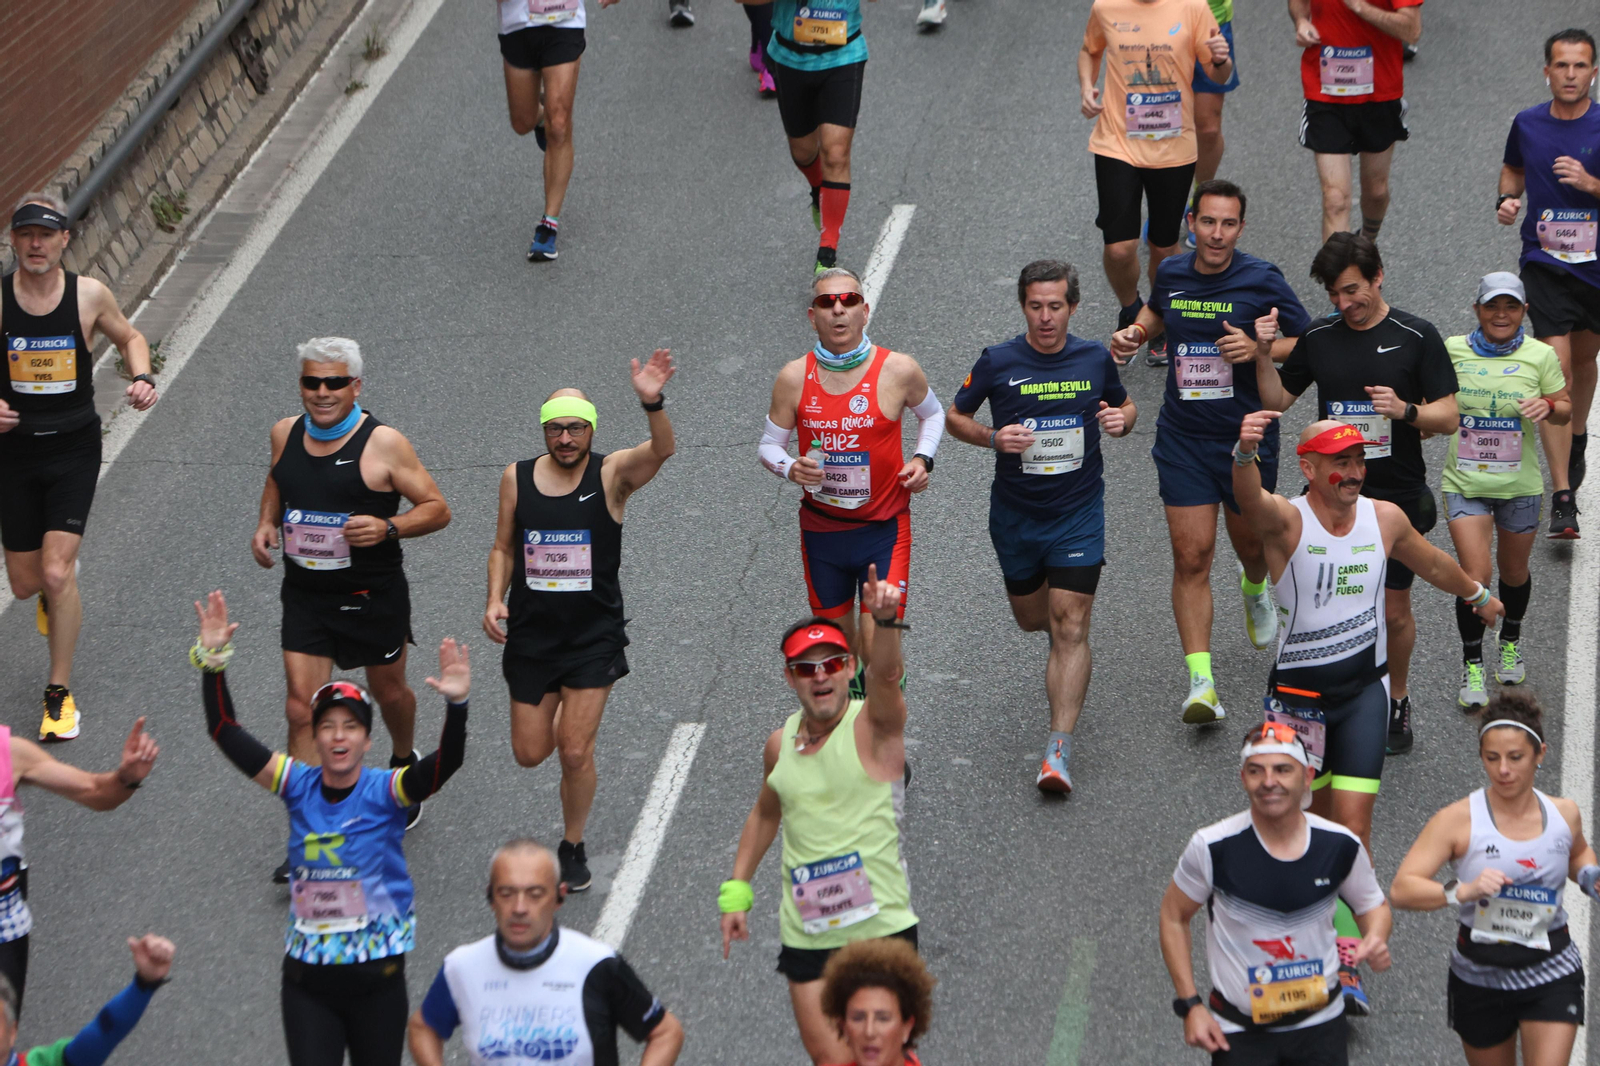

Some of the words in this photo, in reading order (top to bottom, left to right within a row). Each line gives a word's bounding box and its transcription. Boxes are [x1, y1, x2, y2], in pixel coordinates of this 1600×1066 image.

[813, 10, 842, 19] ZURICH
[811, 26, 829, 34] 3751
[1336, 49, 1367, 57] ZURICH
[1145, 94, 1176, 104] ZURICH
[1138, 122, 1171, 130] FERNANDO
[1556, 211, 1590, 220] ZURICH
[1556, 229, 1577, 237] 6464
[1170, 299, 1202, 311] MARATÓN
[1202, 301, 1233, 313] SEVILLA
[30, 339, 68, 349] ZURICH
[30, 359, 53, 368] 6240
[1189, 364, 1211, 373] 7188
[34, 373, 53, 381] YVES
[1020, 381, 1060, 395] MARATÓN
[1060, 380, 1092, 392] SEVILLA
[1183, 379, 1219, 387] RO-MARIO
[1064, 392, 1076, 400] 2023
[1460, 387, 1491, 396] Maratón
[1346, 404, 1375, 413] ZURIC
[802, 418, 838, 429] CLÍNICAS
[1041, 417, 1076, 428] ZURICH
[1478, 420, 1514, 428] ZURICH
[1041, 438, 1064, 447] 9502
[1477, 437, 1500, 447] 8010
[825, 455, 862, 463] ZURICH
[1479, 452, 1497, 460] CATA
[826, 473, 848, 482] 6428
[838, 488, 870, 496] CAMPOS
[303, 514, 341, 525] ZURICH
[303, 533, 326, 543] 7037
[544, 533, 583, 543] ZURICH
[545, 553, 568, 563] 7036
[1338, 564, 1368, 575] CARROS
[1337, 576, 1348, 585] DE
[1335, 585, 1364, 596] FUEGO
[812, 858, 854, 877] ZURICH
[310, 867, 354, 880] ZURICH
[1505, 887, 1549, 903] ZURICH
[1500, 907, 1533, 922] 10249
[1276, 963, 1320, 980] ZURICH
[1279, 990, 1307, 1002] 4195
[479, 1005, 578, 1023] RUNNERS
